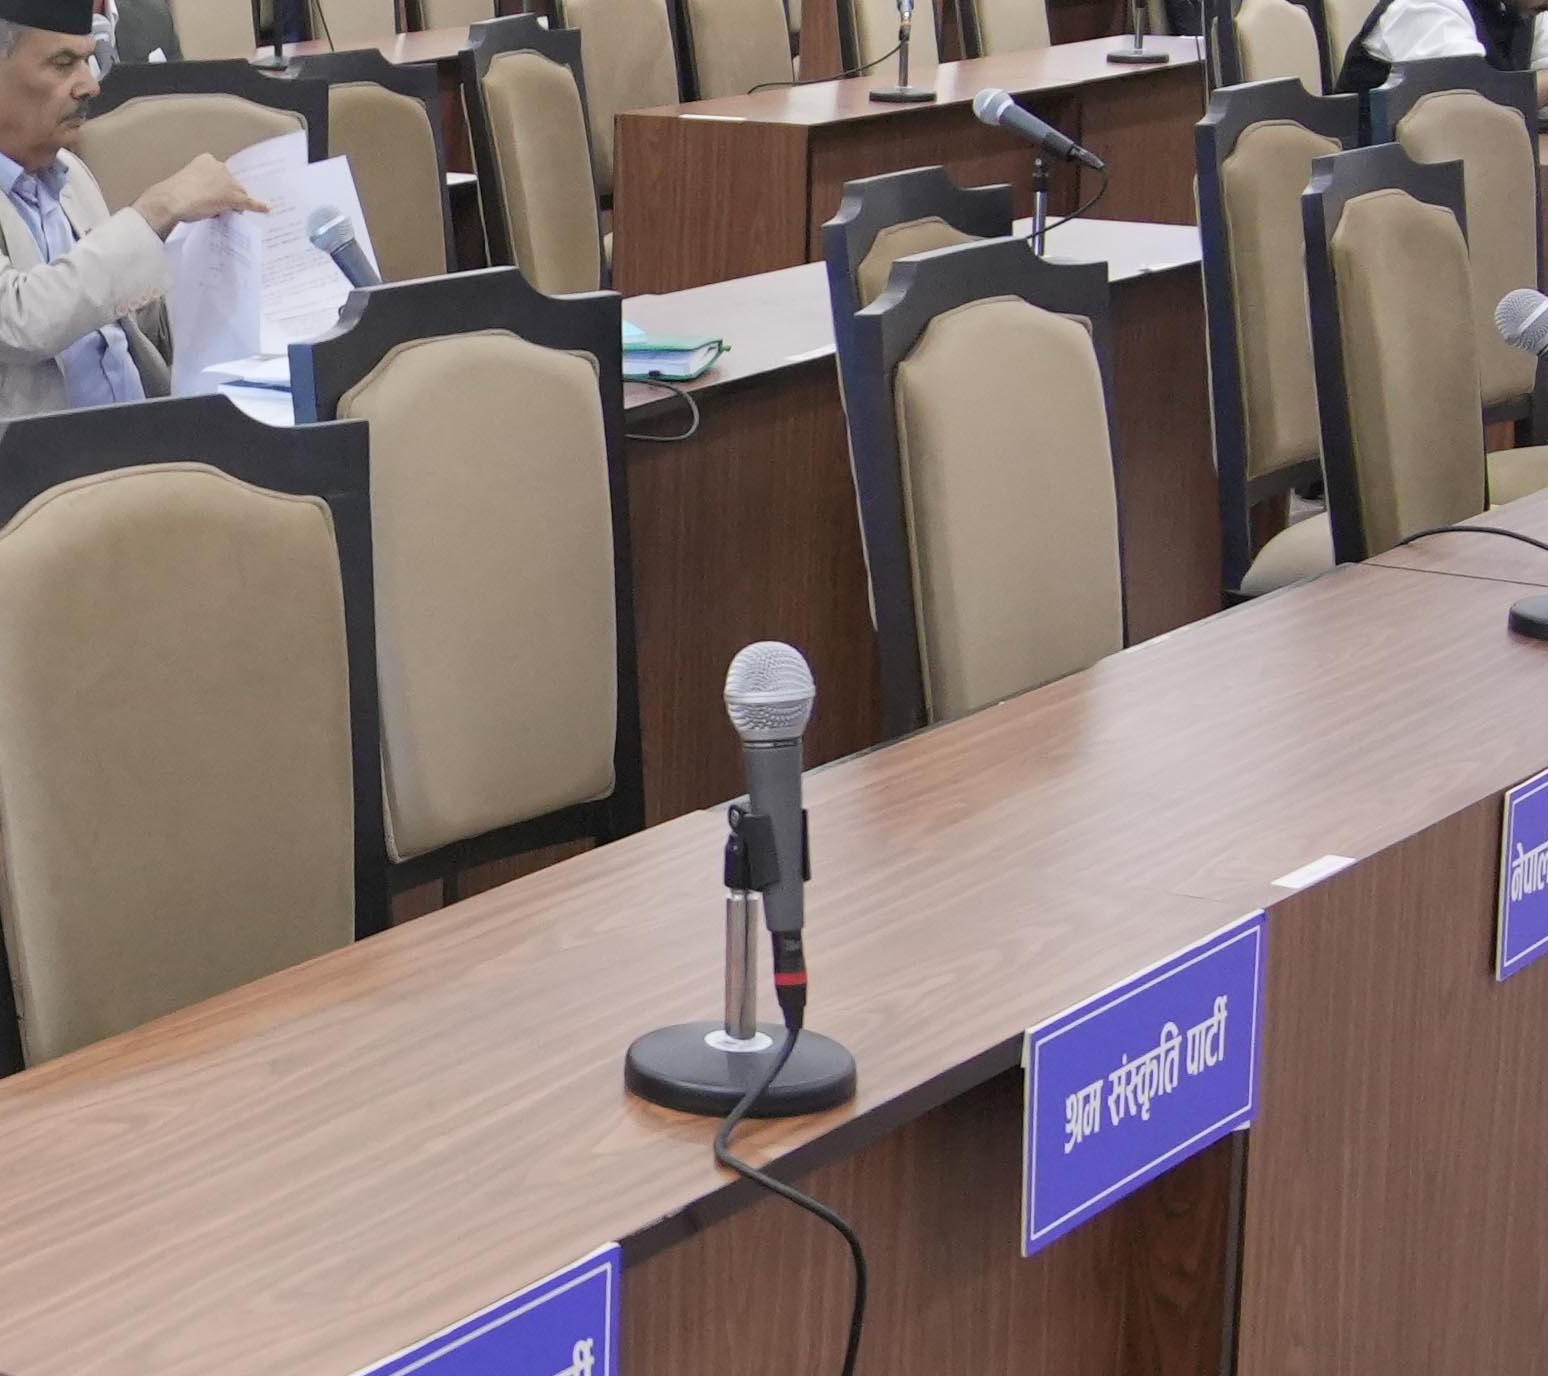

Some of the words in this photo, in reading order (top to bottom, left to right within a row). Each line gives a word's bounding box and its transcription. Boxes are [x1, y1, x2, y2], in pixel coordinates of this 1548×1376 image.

[1065, 1080, 1103, 1154] श्रम
[1108, 1022, 1182, 1126] संस्कृति
[1186, 995, 1228, 1076] पार्टी
